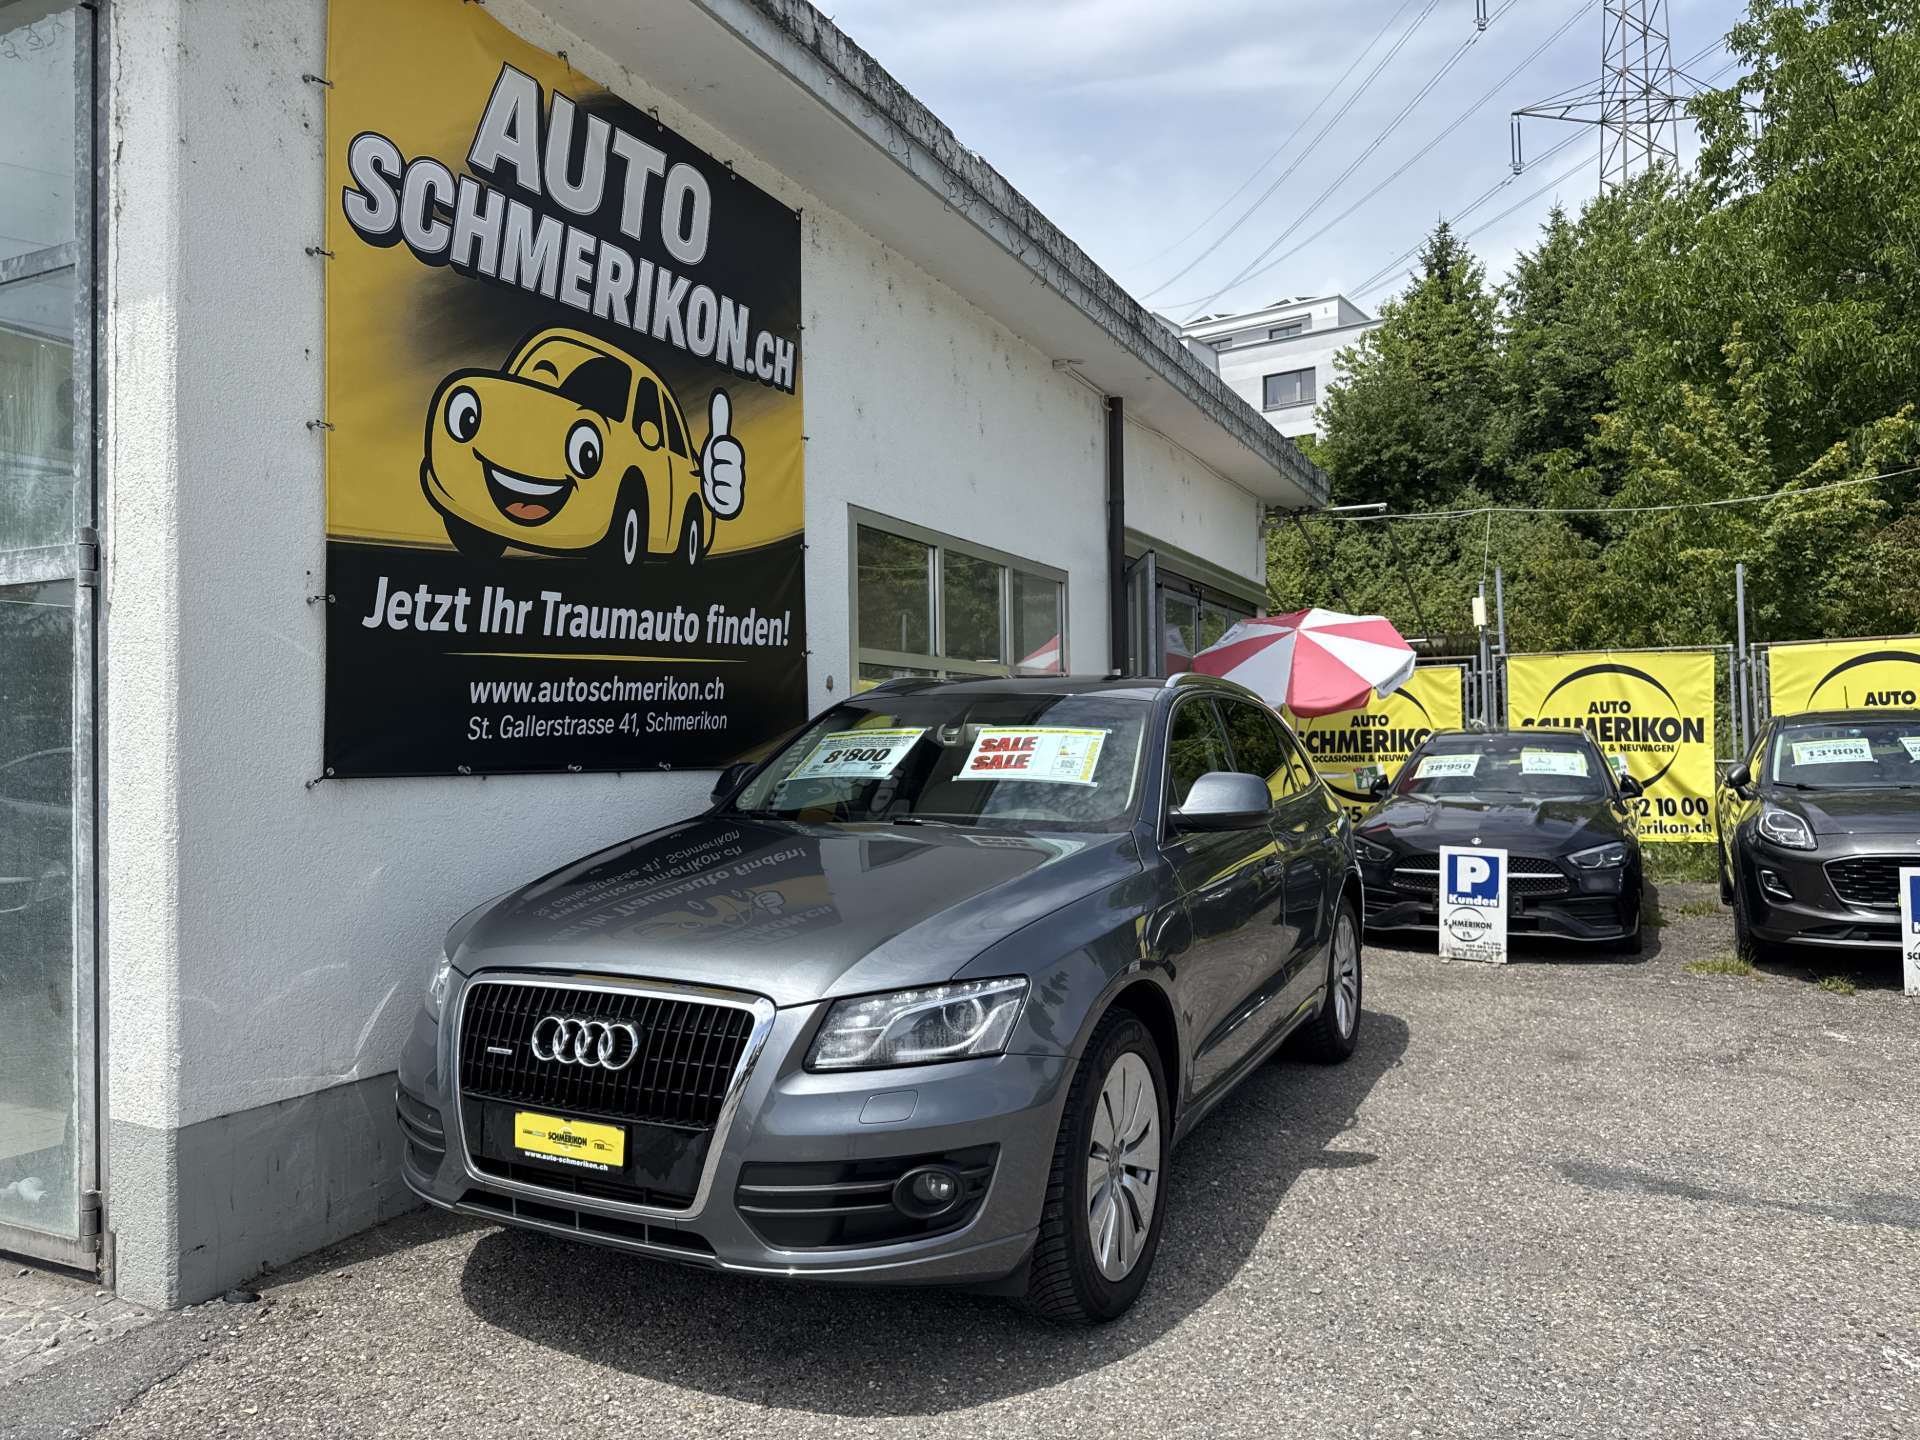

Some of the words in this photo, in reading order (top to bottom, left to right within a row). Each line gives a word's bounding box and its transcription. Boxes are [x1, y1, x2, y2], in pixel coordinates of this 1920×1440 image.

[469, 62, 711, 266] AUTO
[344, 132, 796, 391] SCHMERIKON.CH
[362, 576, 471, 634] Jetzt
[480, 586, 533, 636] Ihr
[540, 590, 700, 644] Traumauto
[706, 605, 791, 647] finden!
[470, 676, 725, 704] www.autoschmerikon.ch
[1864, 690, 1917, 706] AUTO
[1588, 700, 1632, 715] AUTO
[467, 716, 493, 741] St.
[500, 714, 615, 739] Gallerstrasse
[619, 712, 640, 737] 41,
[646, 711, 728, 733] Schmerikon
[1350, 714, 1390, 728] AUTO
[978, 736, 1039, 753] SALE
[1620, 744, 1675, 754] NEUWAGEN
[823, 748, 892, 764] 8'800
[970, 754, 1032, 771] SALE
[1311, 754, 1366, 764] OCCASIONEN
[1656, 797, 1677, 817] 10
[1681, 797, 1709, 817] 00
[1456, 855, 1491, 894] P
[1448, 893, 1498, 907] Kunden
[524, 1150, 609, 1171] www.auto-schmerikon.ch
